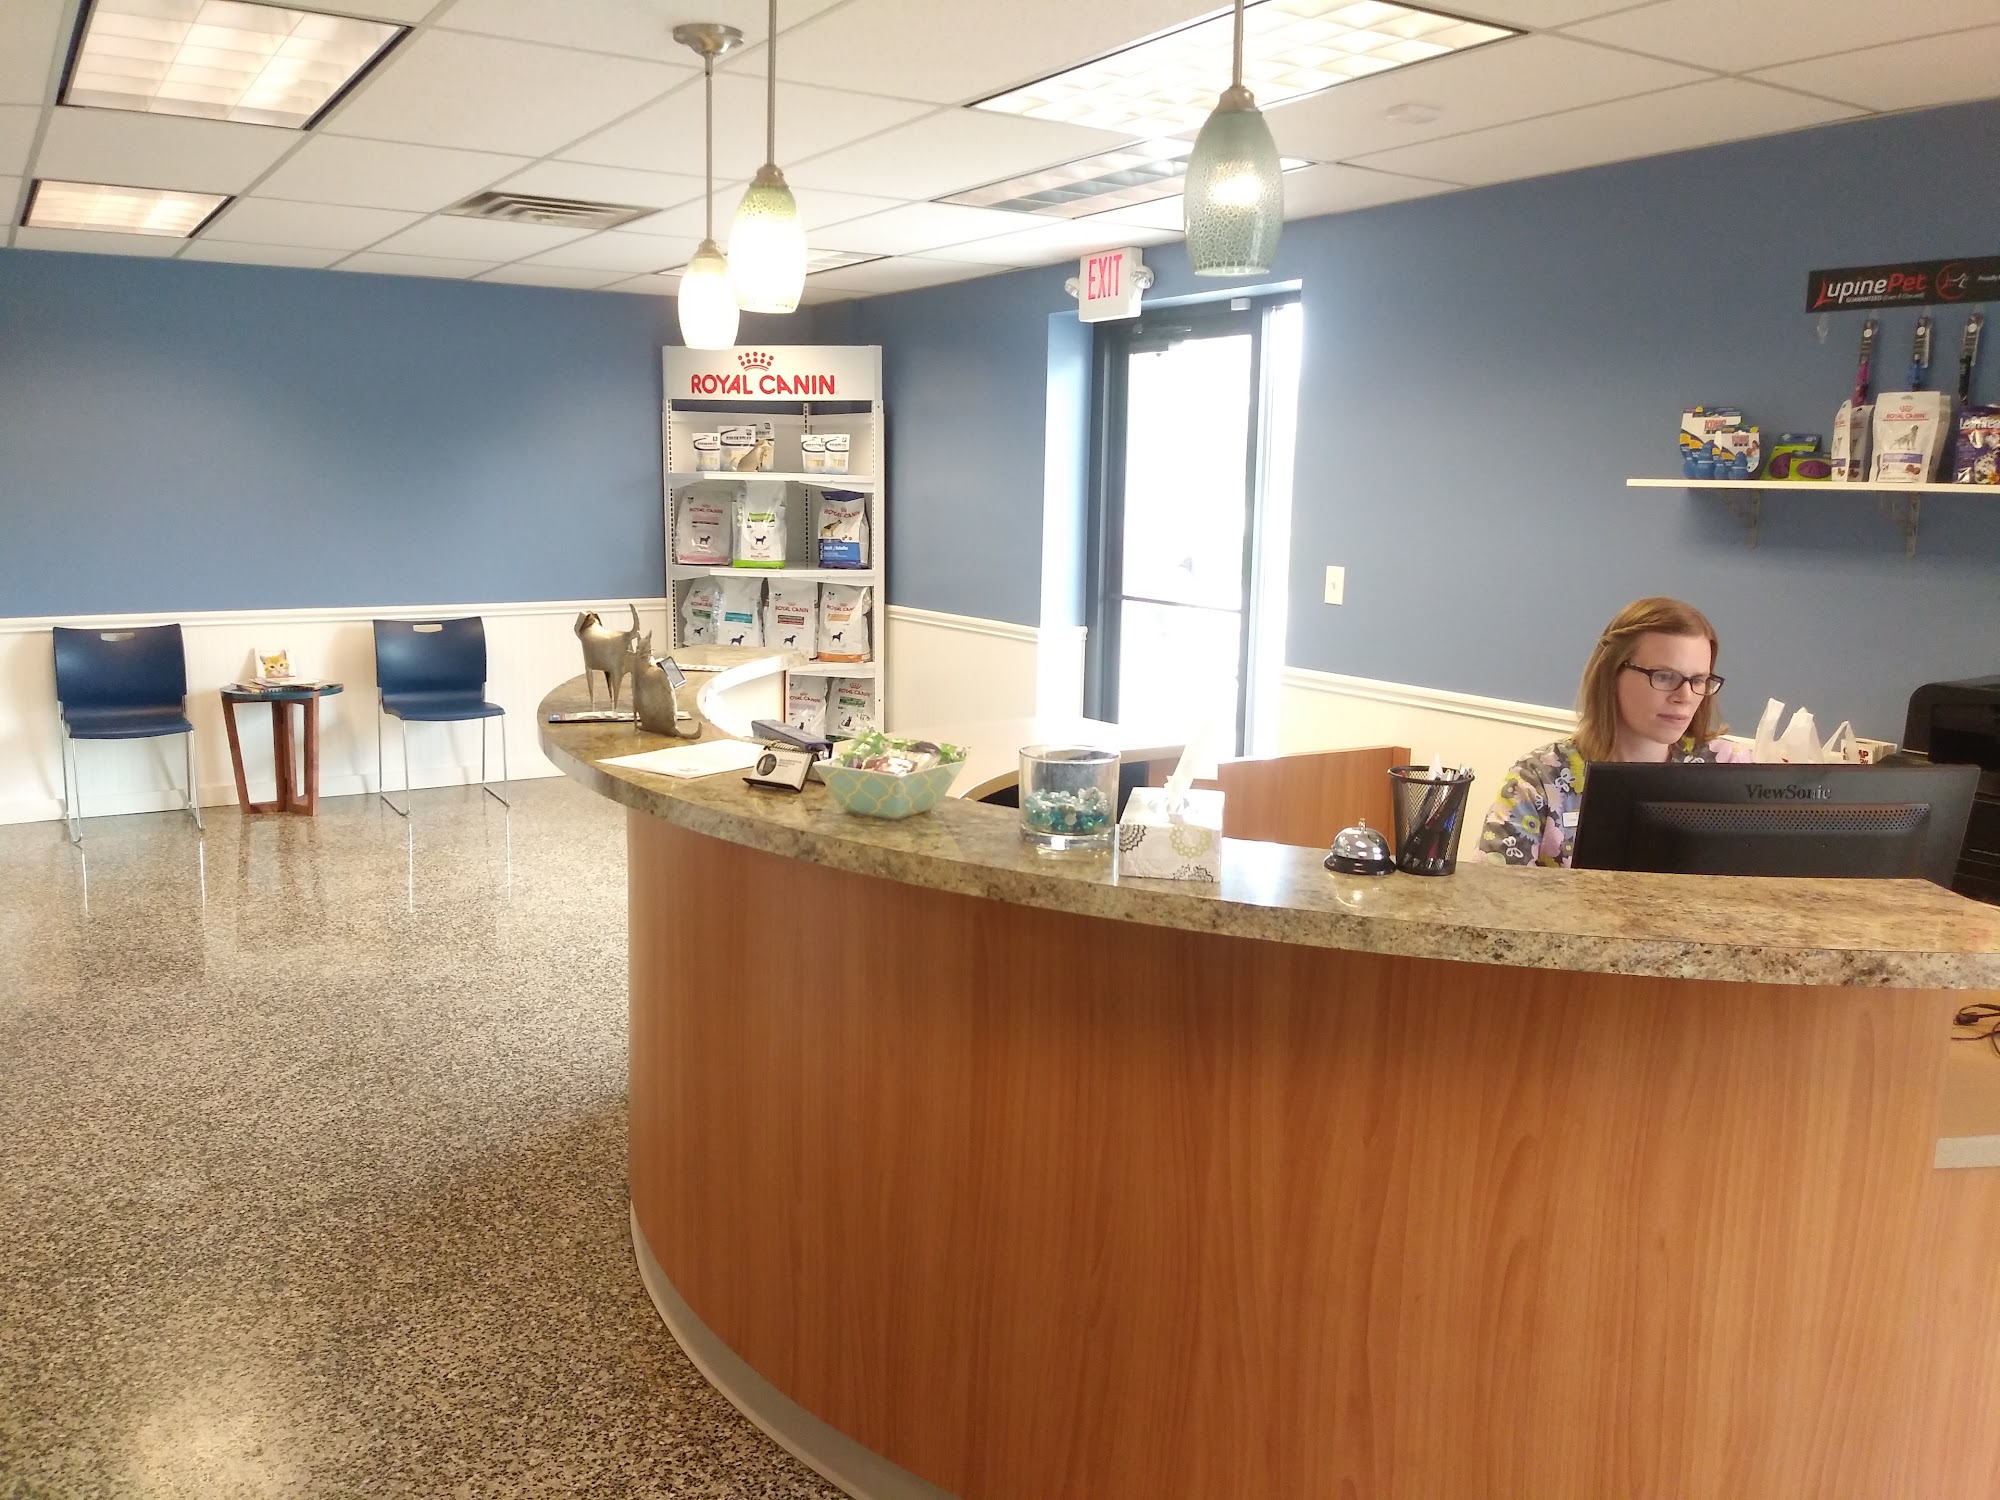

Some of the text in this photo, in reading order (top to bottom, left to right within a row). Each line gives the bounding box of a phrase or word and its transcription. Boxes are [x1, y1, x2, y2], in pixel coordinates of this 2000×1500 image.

[1088, 254, 1123, 300] EXIT
[691, 374, 836, 395] ROYAL CANIN
[824, 508, 842, 518] ROYAL
[838, 687, 853, 695] ROYAL
[1745, 784, 1832, 800] ViewSonic
